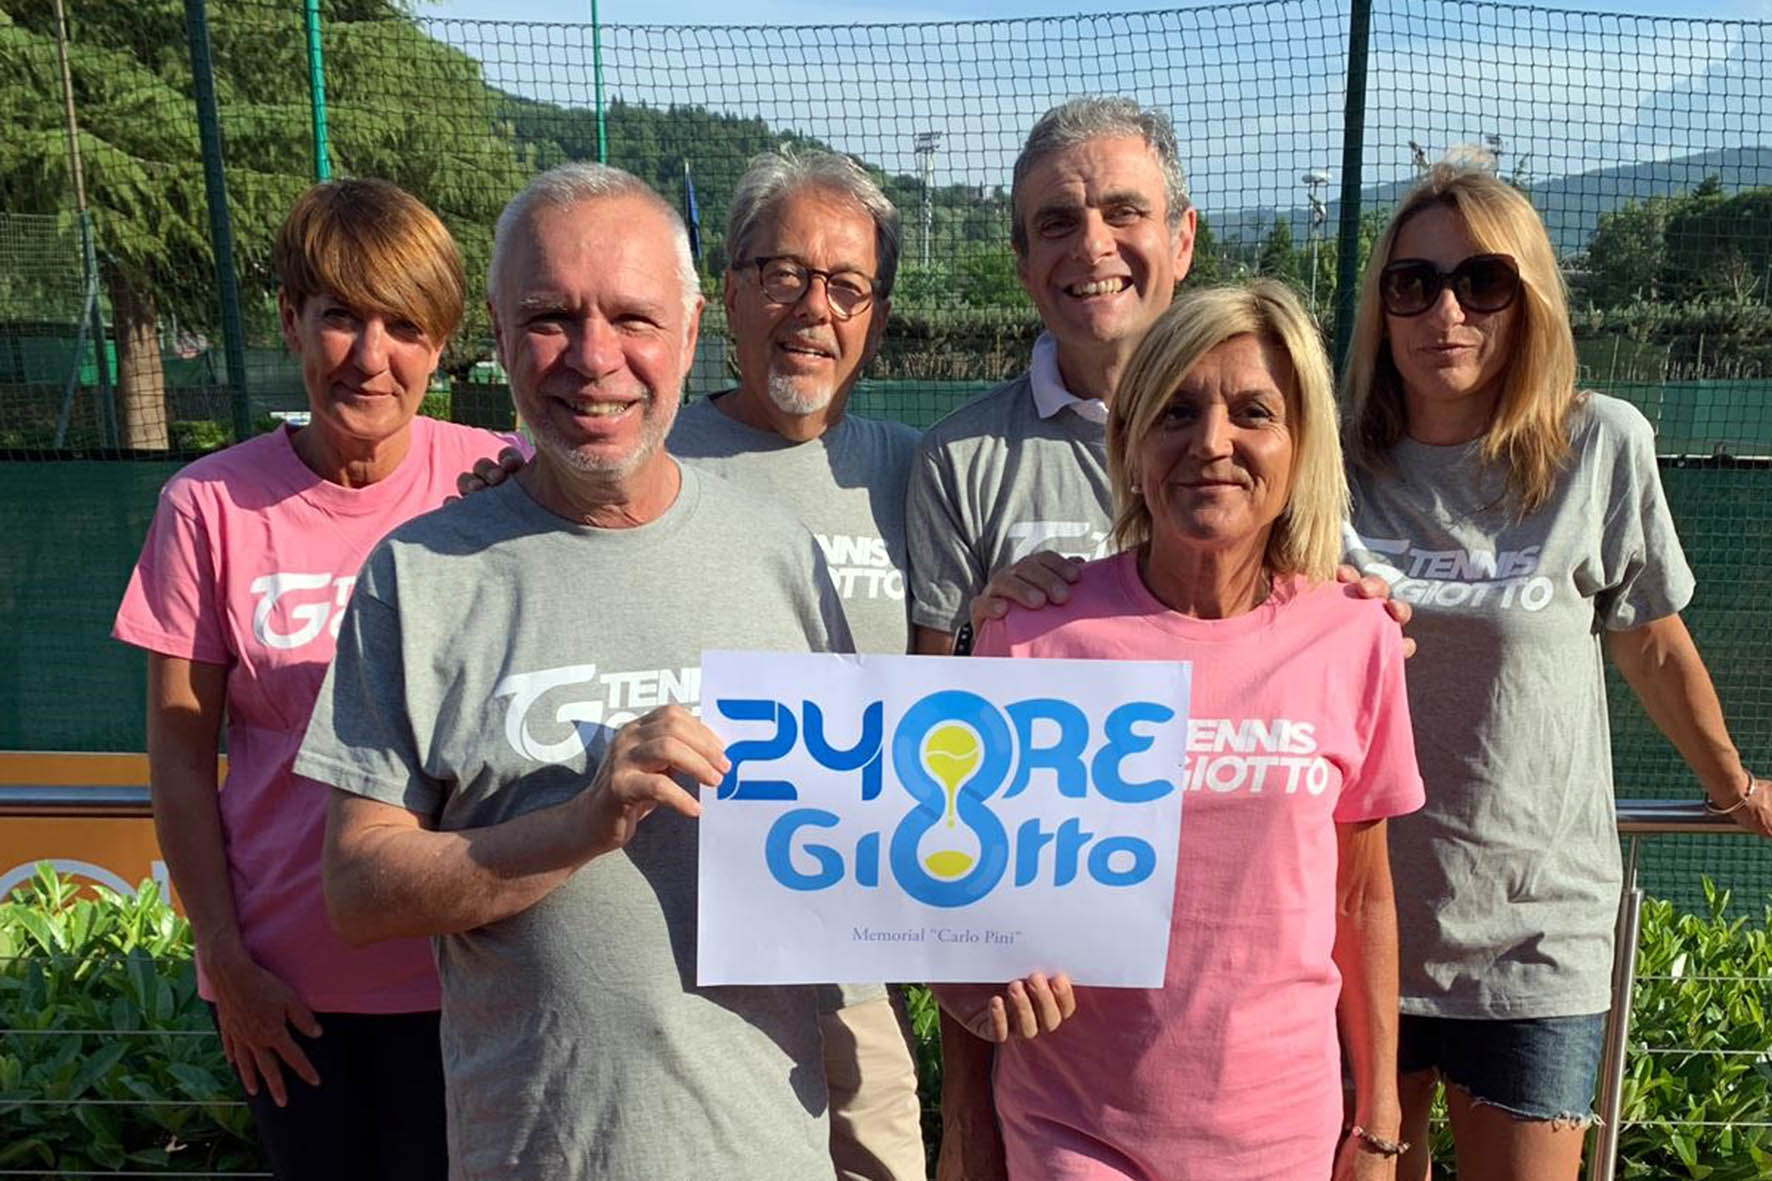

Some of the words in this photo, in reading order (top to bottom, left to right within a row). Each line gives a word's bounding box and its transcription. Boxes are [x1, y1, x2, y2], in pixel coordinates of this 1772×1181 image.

[813, 533, 890, 567] NNIS
[1407, 545, 1541, 580] TENNIS
[1391, 576, 1554, 612] GIOTTO
[1186, 718, 1318, 755] ENNIS
[1184, 754, 1329, 796] IOTTO
[852, 927, 925, 942] Memorial
